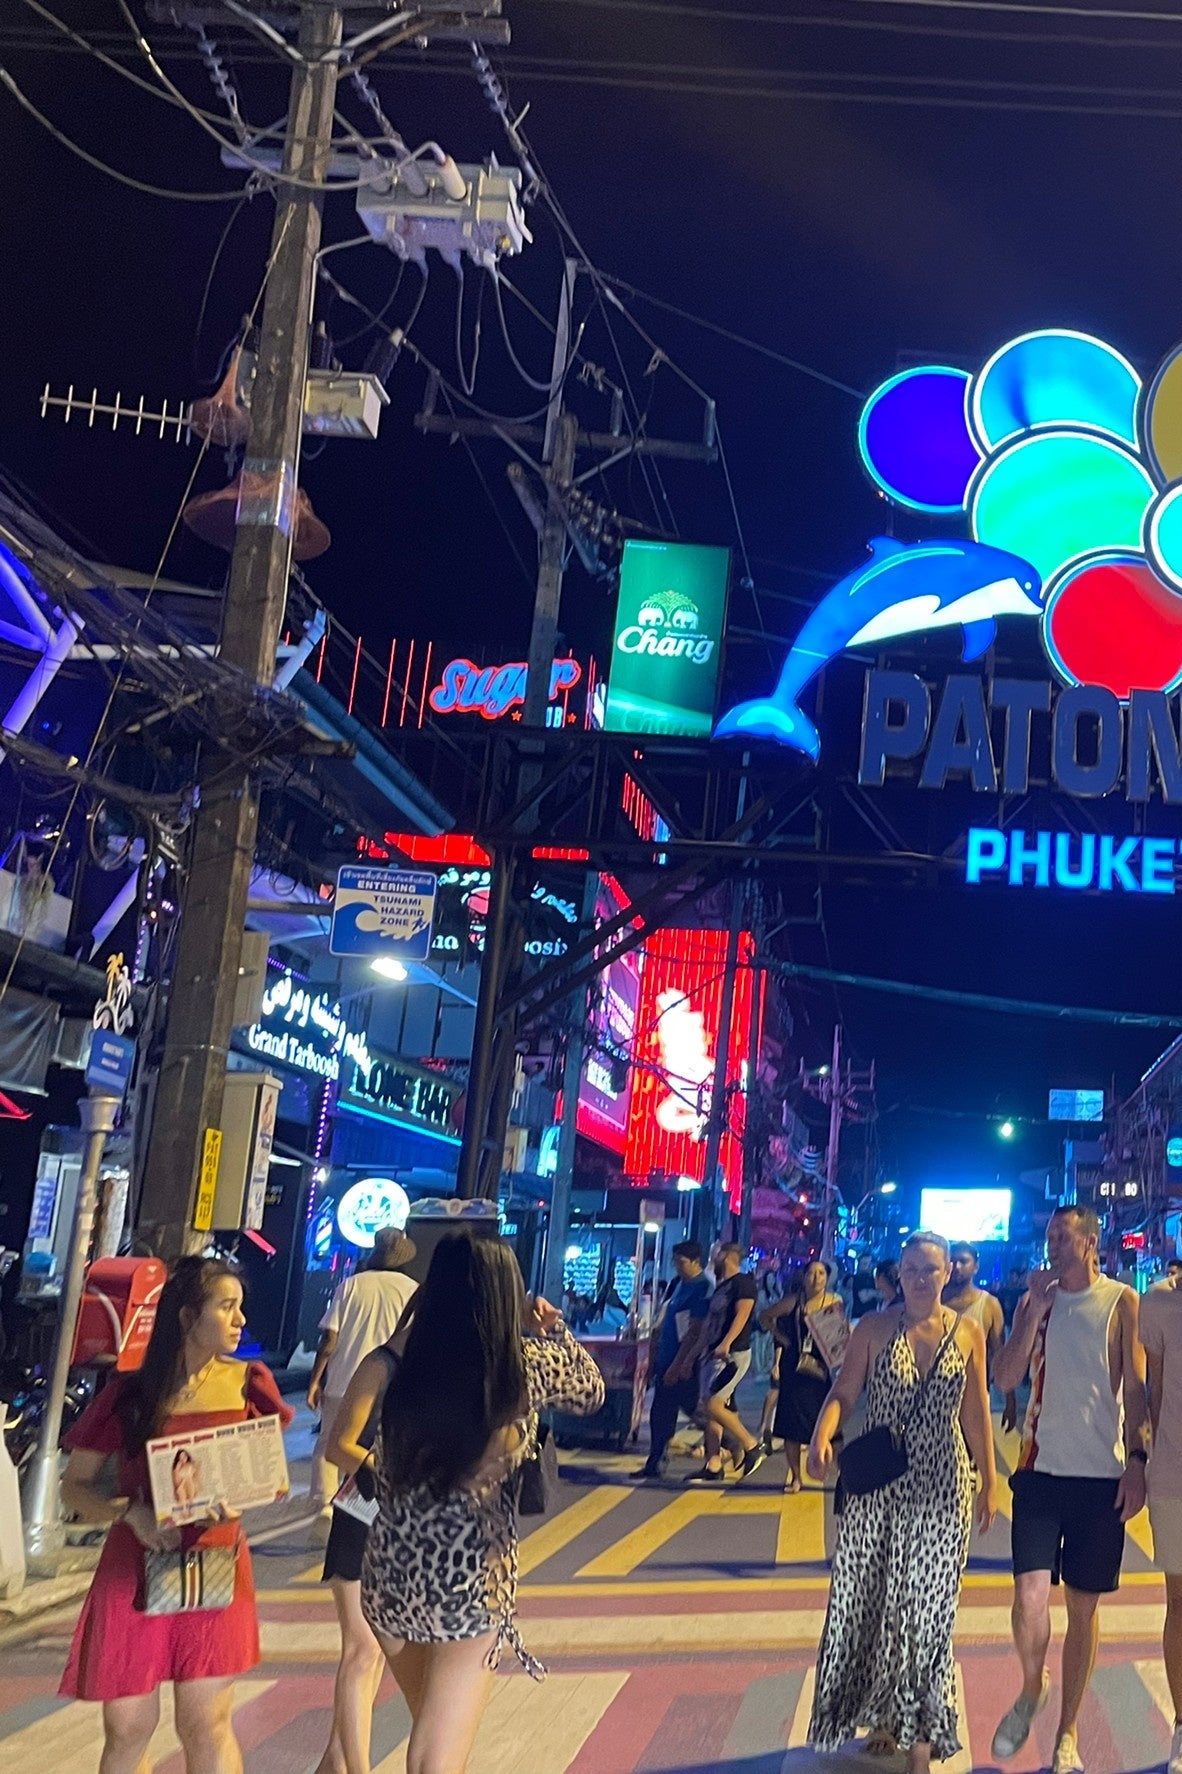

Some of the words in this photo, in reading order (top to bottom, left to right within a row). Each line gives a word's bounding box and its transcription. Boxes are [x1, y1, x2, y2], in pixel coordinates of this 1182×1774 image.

[617, 626, 714, 664] Chang
[430, 659, 581, 719] Sugr
[357, 880, 417, 894] ENTERING
[373, 895, 422, 906] TSUNAMI
[380, 906, 425, 917] HAZARD
[379, 917, 410, 927] ZONE
[249, 1023, 289, 1060] Grand
[288, 1037, 340, 1080] Tarboosh
